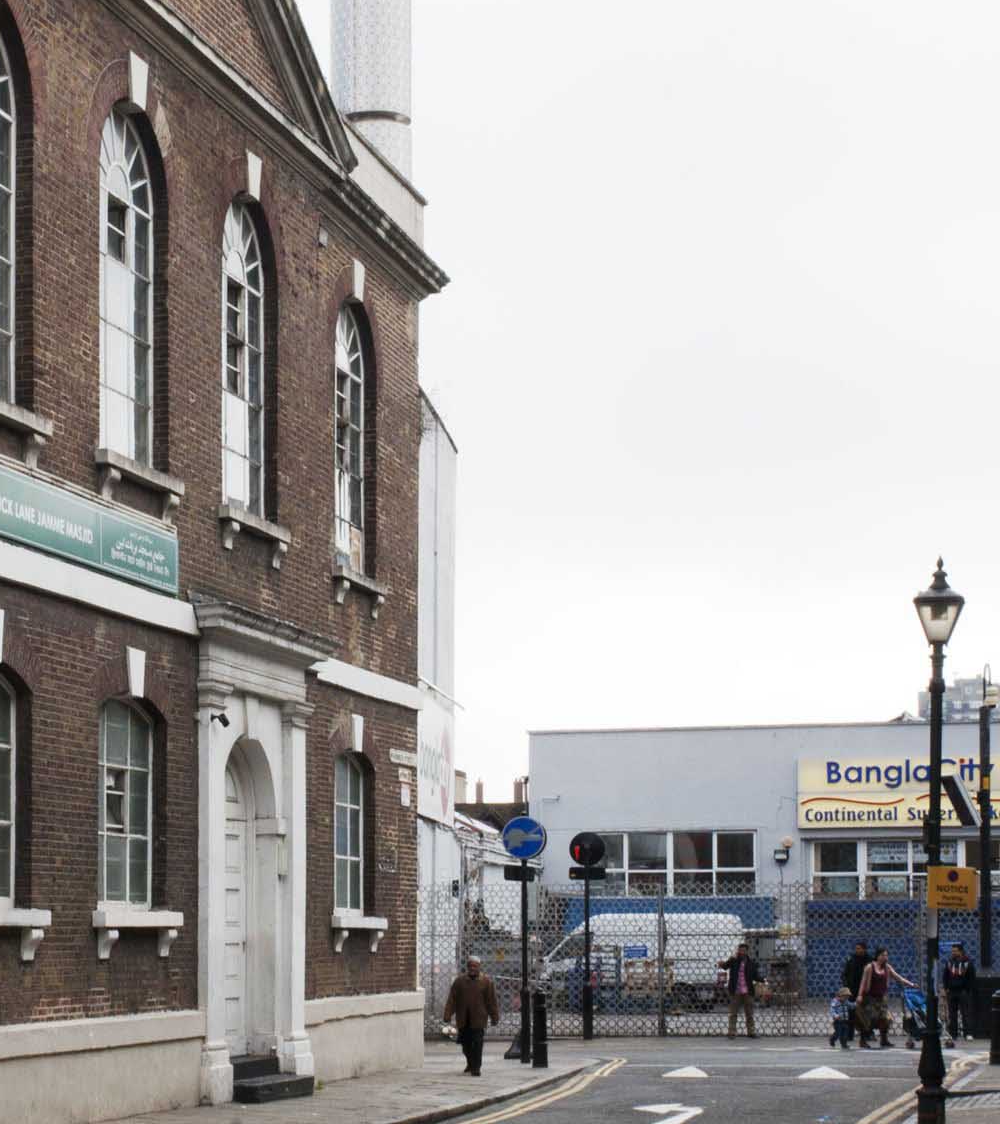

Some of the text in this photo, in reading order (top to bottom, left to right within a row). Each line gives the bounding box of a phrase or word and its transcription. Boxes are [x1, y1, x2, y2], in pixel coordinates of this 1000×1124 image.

[15, 502, 36, 525] LANE
[65, 521, 94, 545] MASJID
[805, 807, 898, 822] Continental
[936, 884, 969, 893] NOTICE
